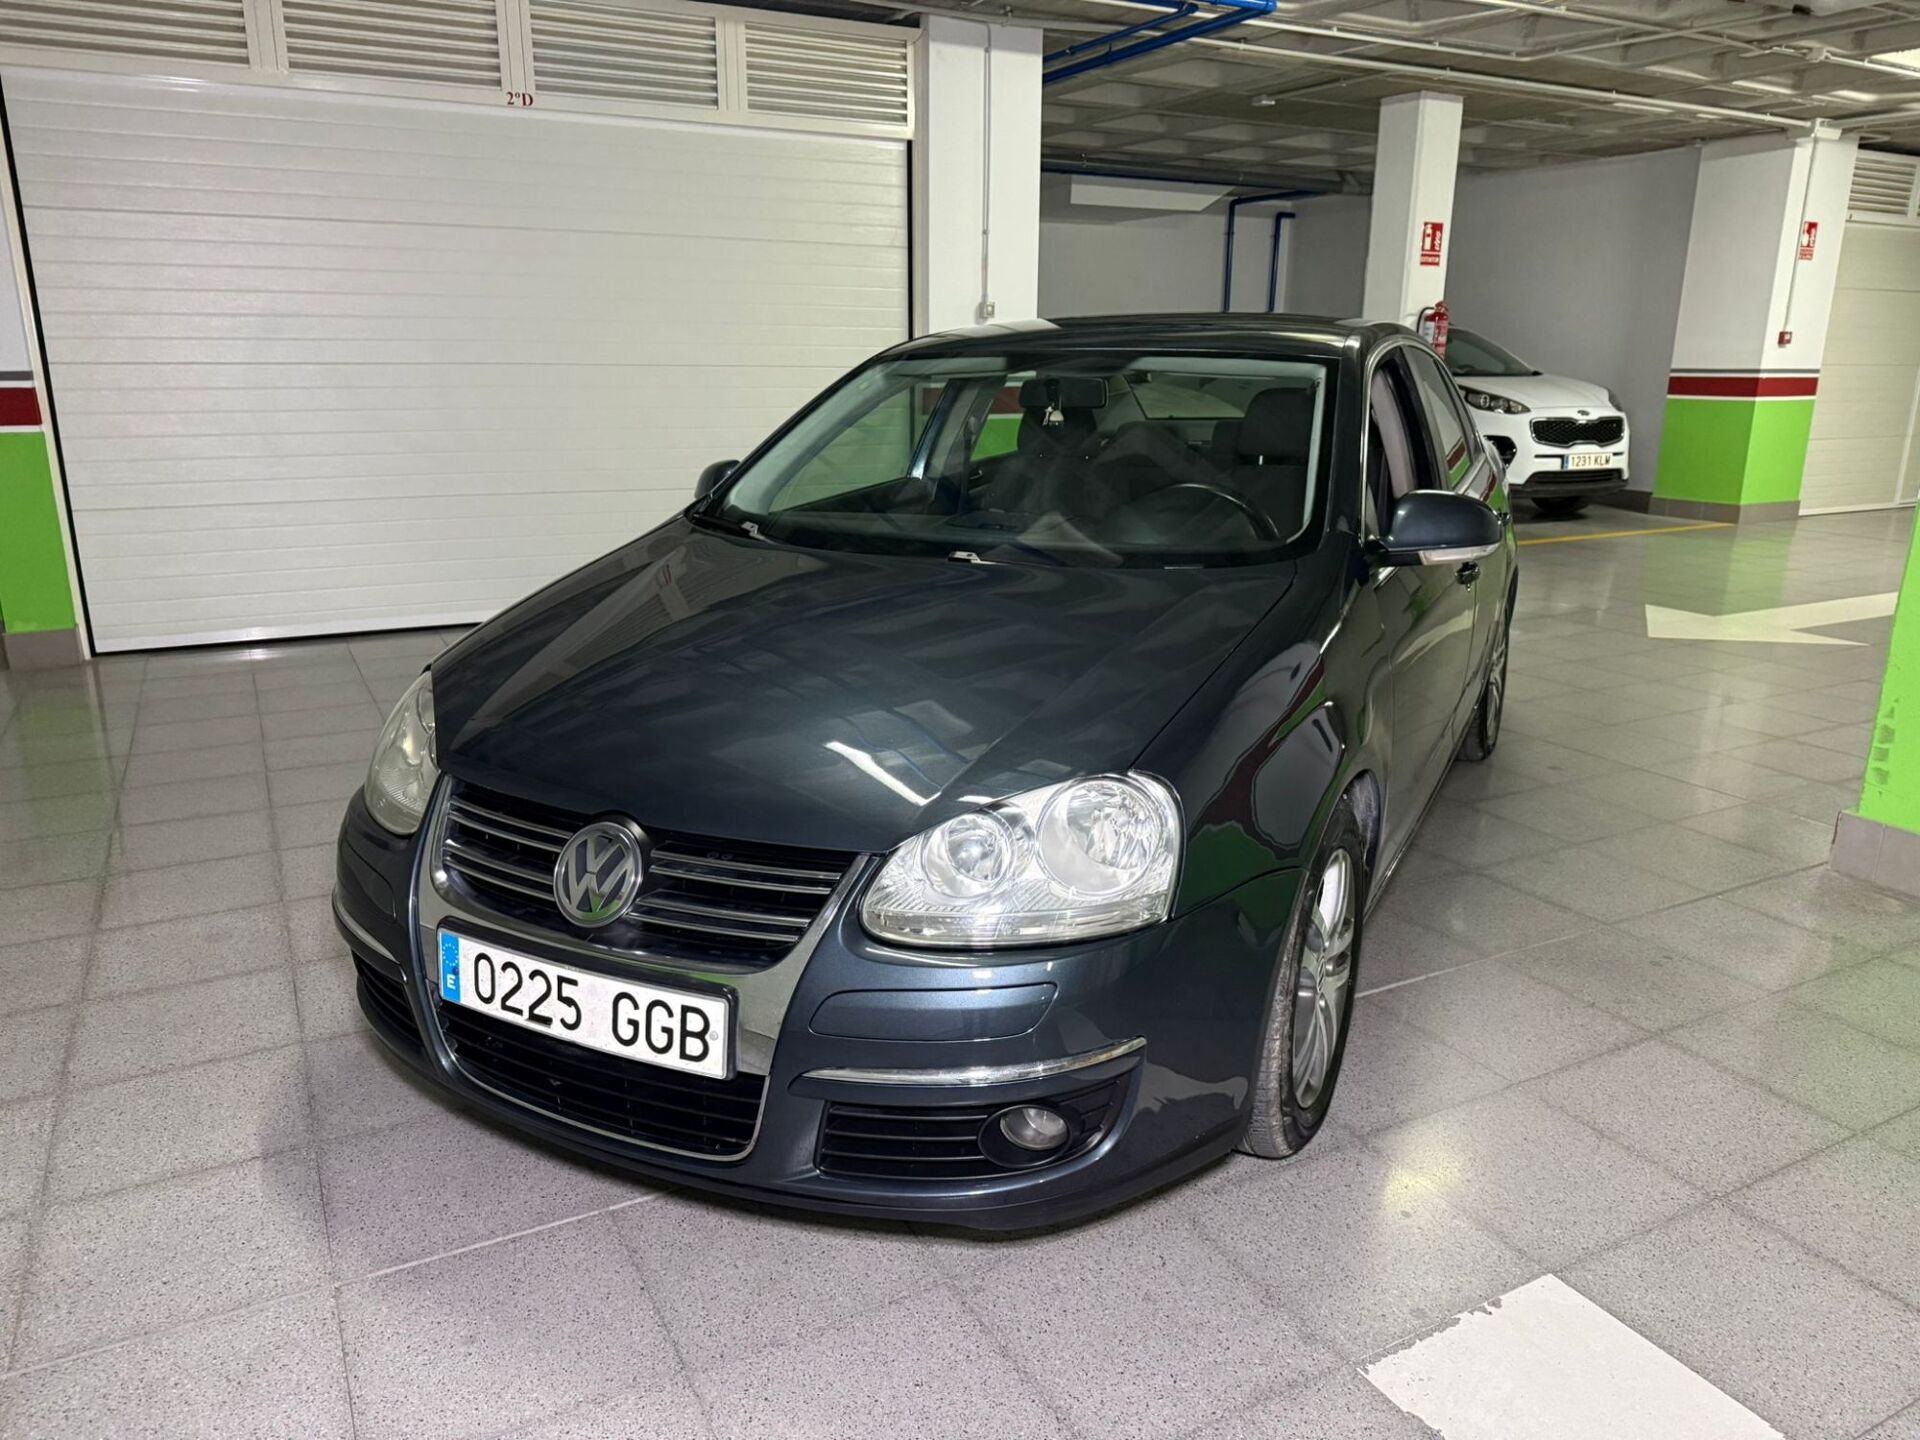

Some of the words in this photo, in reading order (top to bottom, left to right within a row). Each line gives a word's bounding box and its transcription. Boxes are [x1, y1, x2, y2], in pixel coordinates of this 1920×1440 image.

[1571, 455, 1592, 467] 1231
[557, 826, 639, 922] VW
[446, 973, 457, 990] E
[474, 952, 582, 1031] 0225
[611, 991, 711, 1063] GGB
